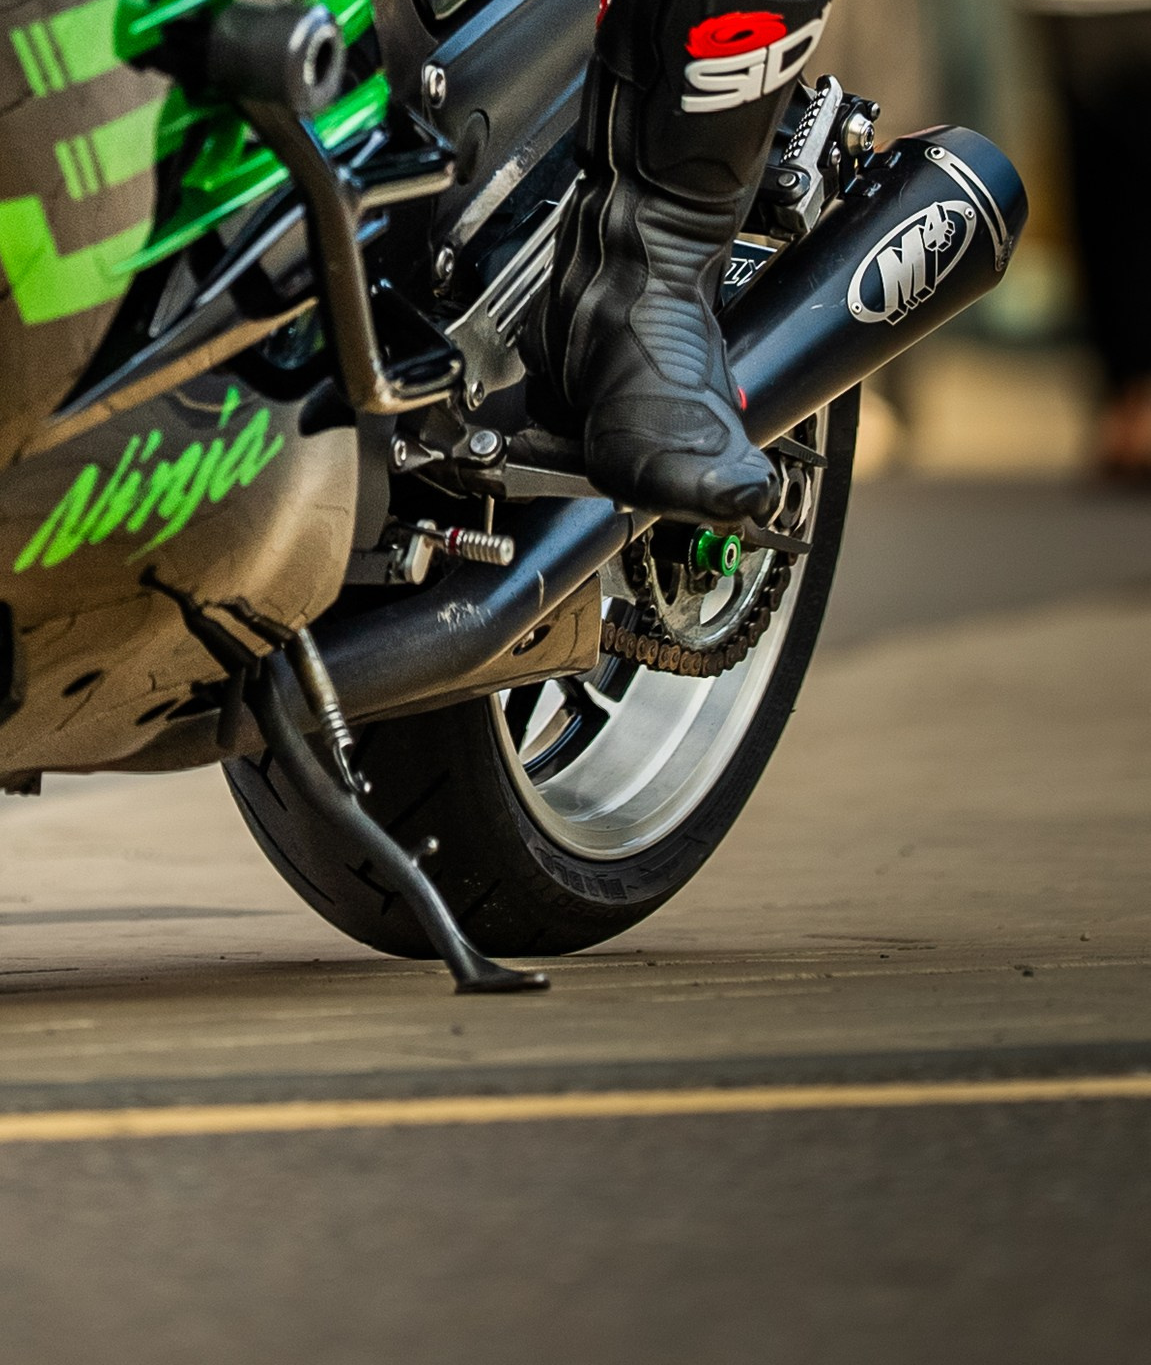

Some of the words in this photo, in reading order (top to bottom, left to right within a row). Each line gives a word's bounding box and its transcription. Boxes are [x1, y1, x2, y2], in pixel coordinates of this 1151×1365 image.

[681, 1, 832, 113] SID
[876, 201, 955, 326] M4
[13, 386, 284, 572] Ninja
